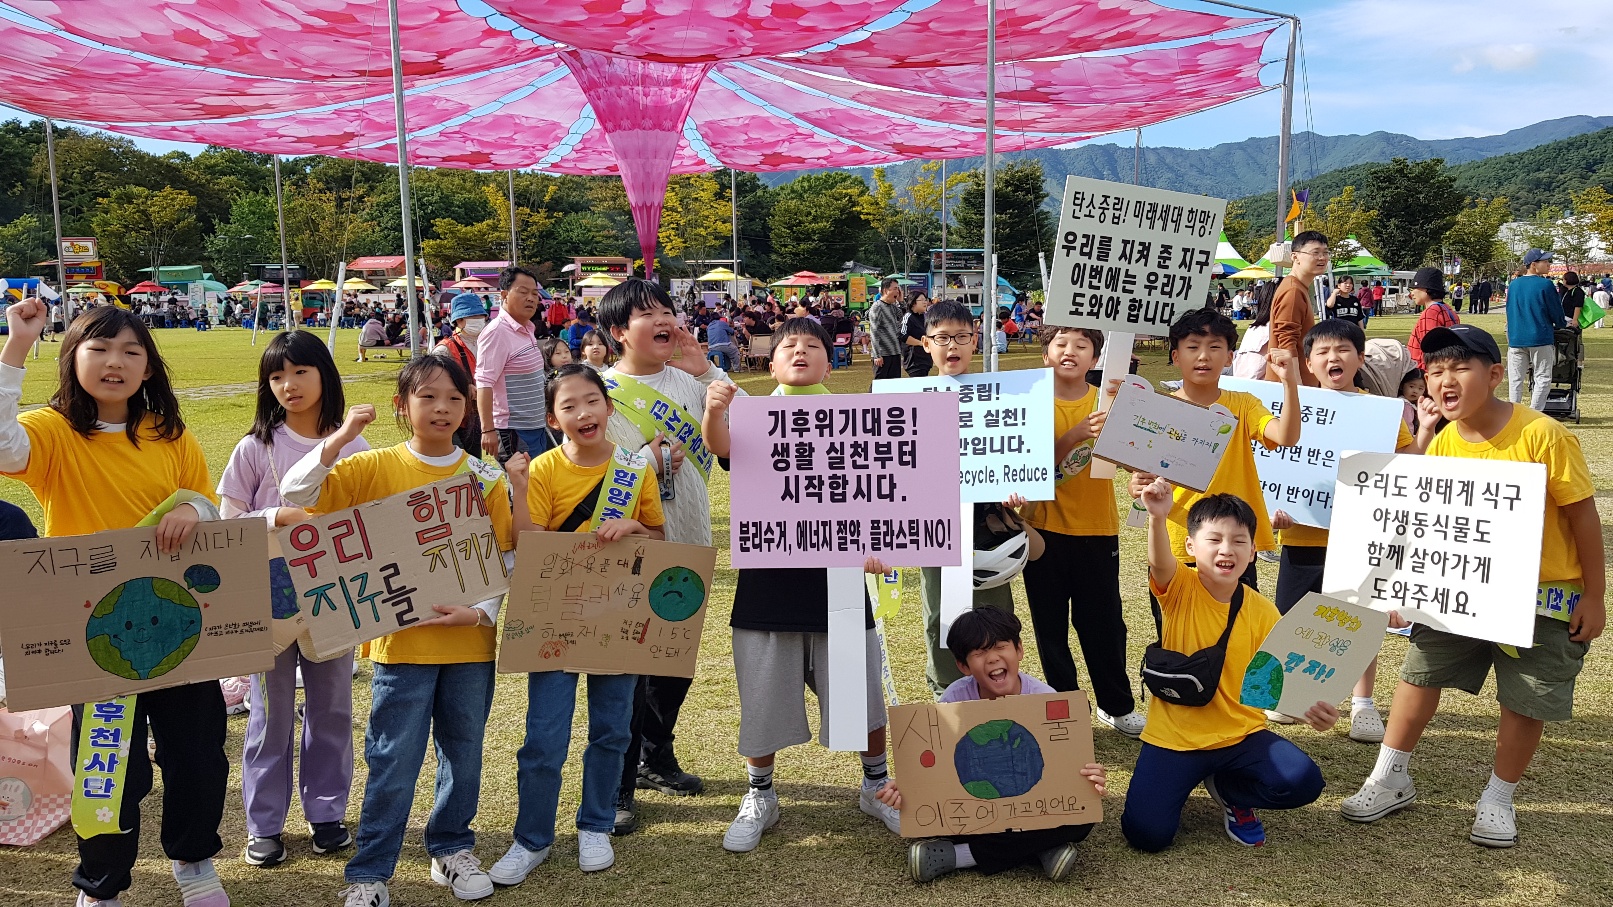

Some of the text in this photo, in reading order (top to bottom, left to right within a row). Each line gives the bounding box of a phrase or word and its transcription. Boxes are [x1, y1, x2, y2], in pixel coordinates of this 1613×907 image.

[1072, 190, 1217, 238] 탄소중립! 미래세대 희망!
[1061, 231, 1211, 274] 우리를 지켜 준 지구
[1070, 262, 1192, 301] 이번에는 우리가
[1069, 292, 1121, 321] 도와야
[767, 406, 918, 439] 기후위기대응!
[983, 407, 1027, 428] 실천!
[1271, 401, 1337, 426] 탄중립!
[770, 440, 918, 472] 생활 실천부터
[1003, 463, 1048, 483] Reduce
[1307, 447, 1336, 468] 반은
[780, 473, 907, 504] 시작합시다.
[1286, 485, 1333, 510] 반이다.
[1353, 470, 1522, 511] 우리도 생태계 식구
[289, 473, 489, 579] 우리 함께
[738, 518, 952, 556] 분리수거, 에너지 절약, 플라스틱 NO!
[1372, 507, 1492, 544] 야생동식물도
[23, 544, 118, 577] 지구를
[303, 524, 509, 631] 지구를 지키기
[1367, 541, 1492, 584] 함께 살아가게
[613, 581, 646, 609] 사용
[1370, 577, 1477, 617] 도와주세요.
[83, 696, 127, 799] 후천사단
